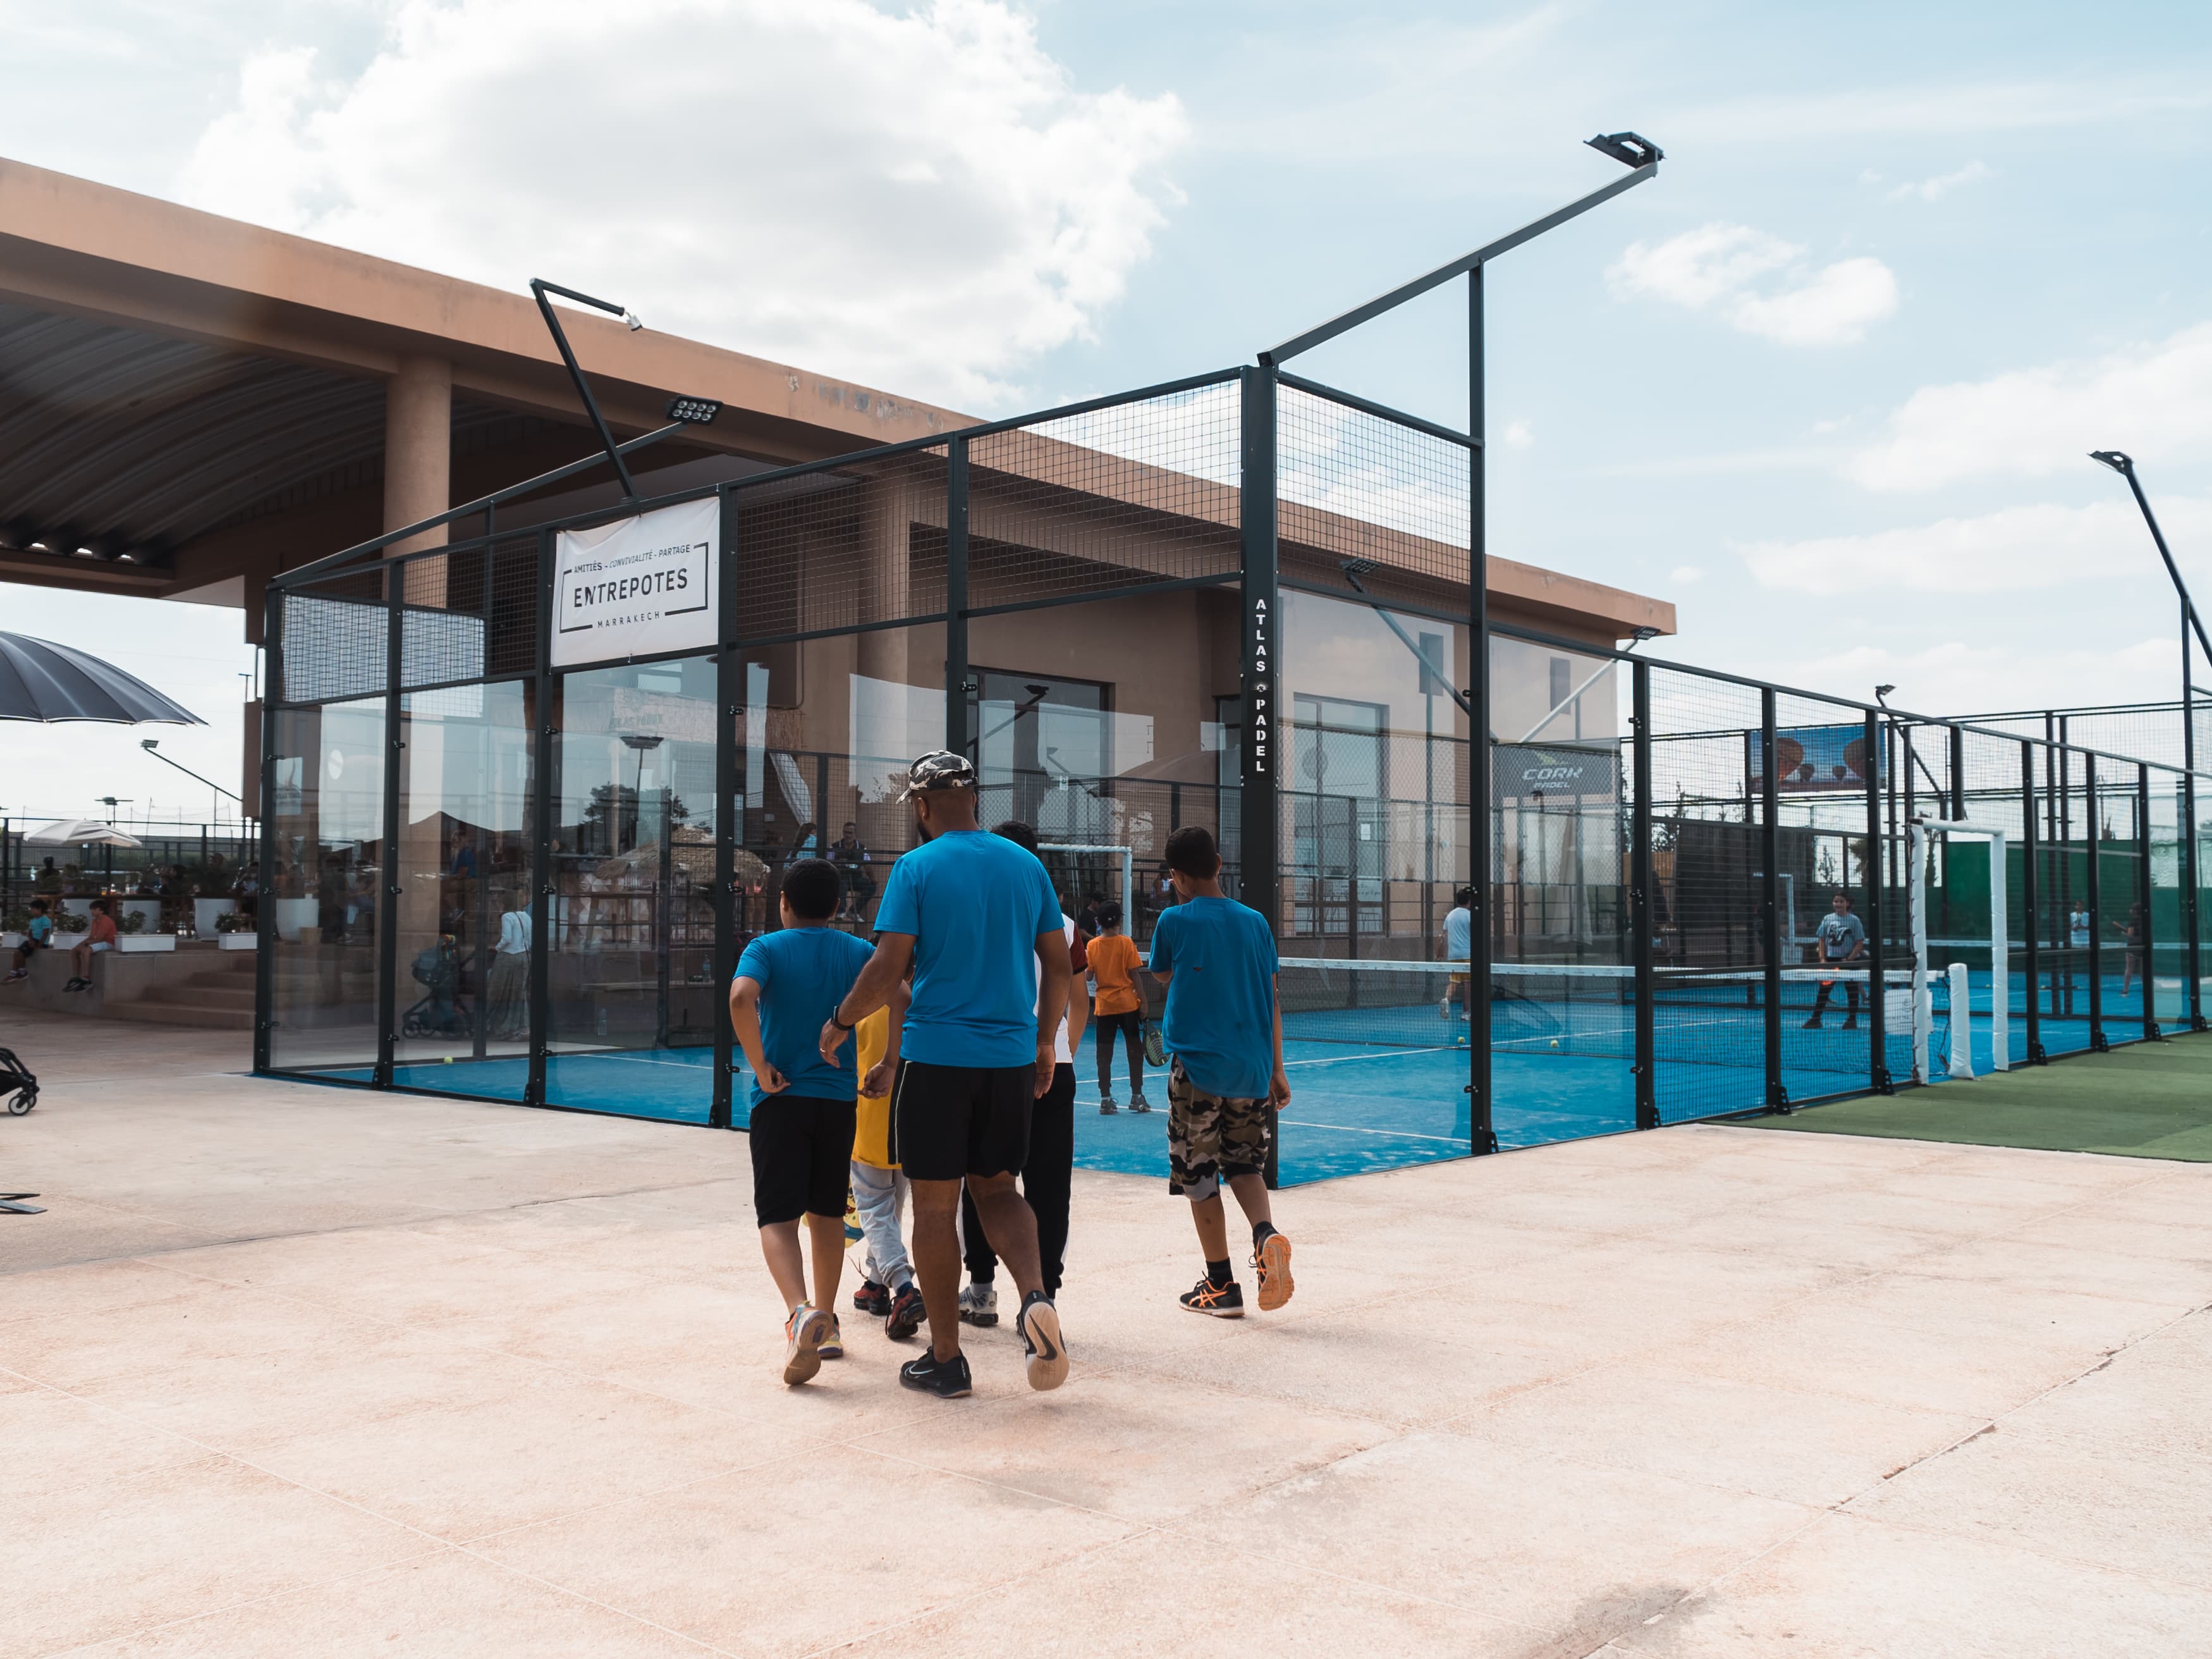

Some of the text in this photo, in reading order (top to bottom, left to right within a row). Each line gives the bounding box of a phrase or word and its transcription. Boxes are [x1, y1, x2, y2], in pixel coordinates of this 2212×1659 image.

[574, 560, 602, 573] AMITIÉS
[609, 549, 653, 568] CONVIVIALITÉ
[658, 544, 690, 558] PARTAGE
[573, 568, 688, 608] ENTREPOTES
[597, 611, 660, 629] MARRAKECH
[1256, 598, 1267, 772] ATLAS PADEL
[1522, 767, 1584, 781] CORK
